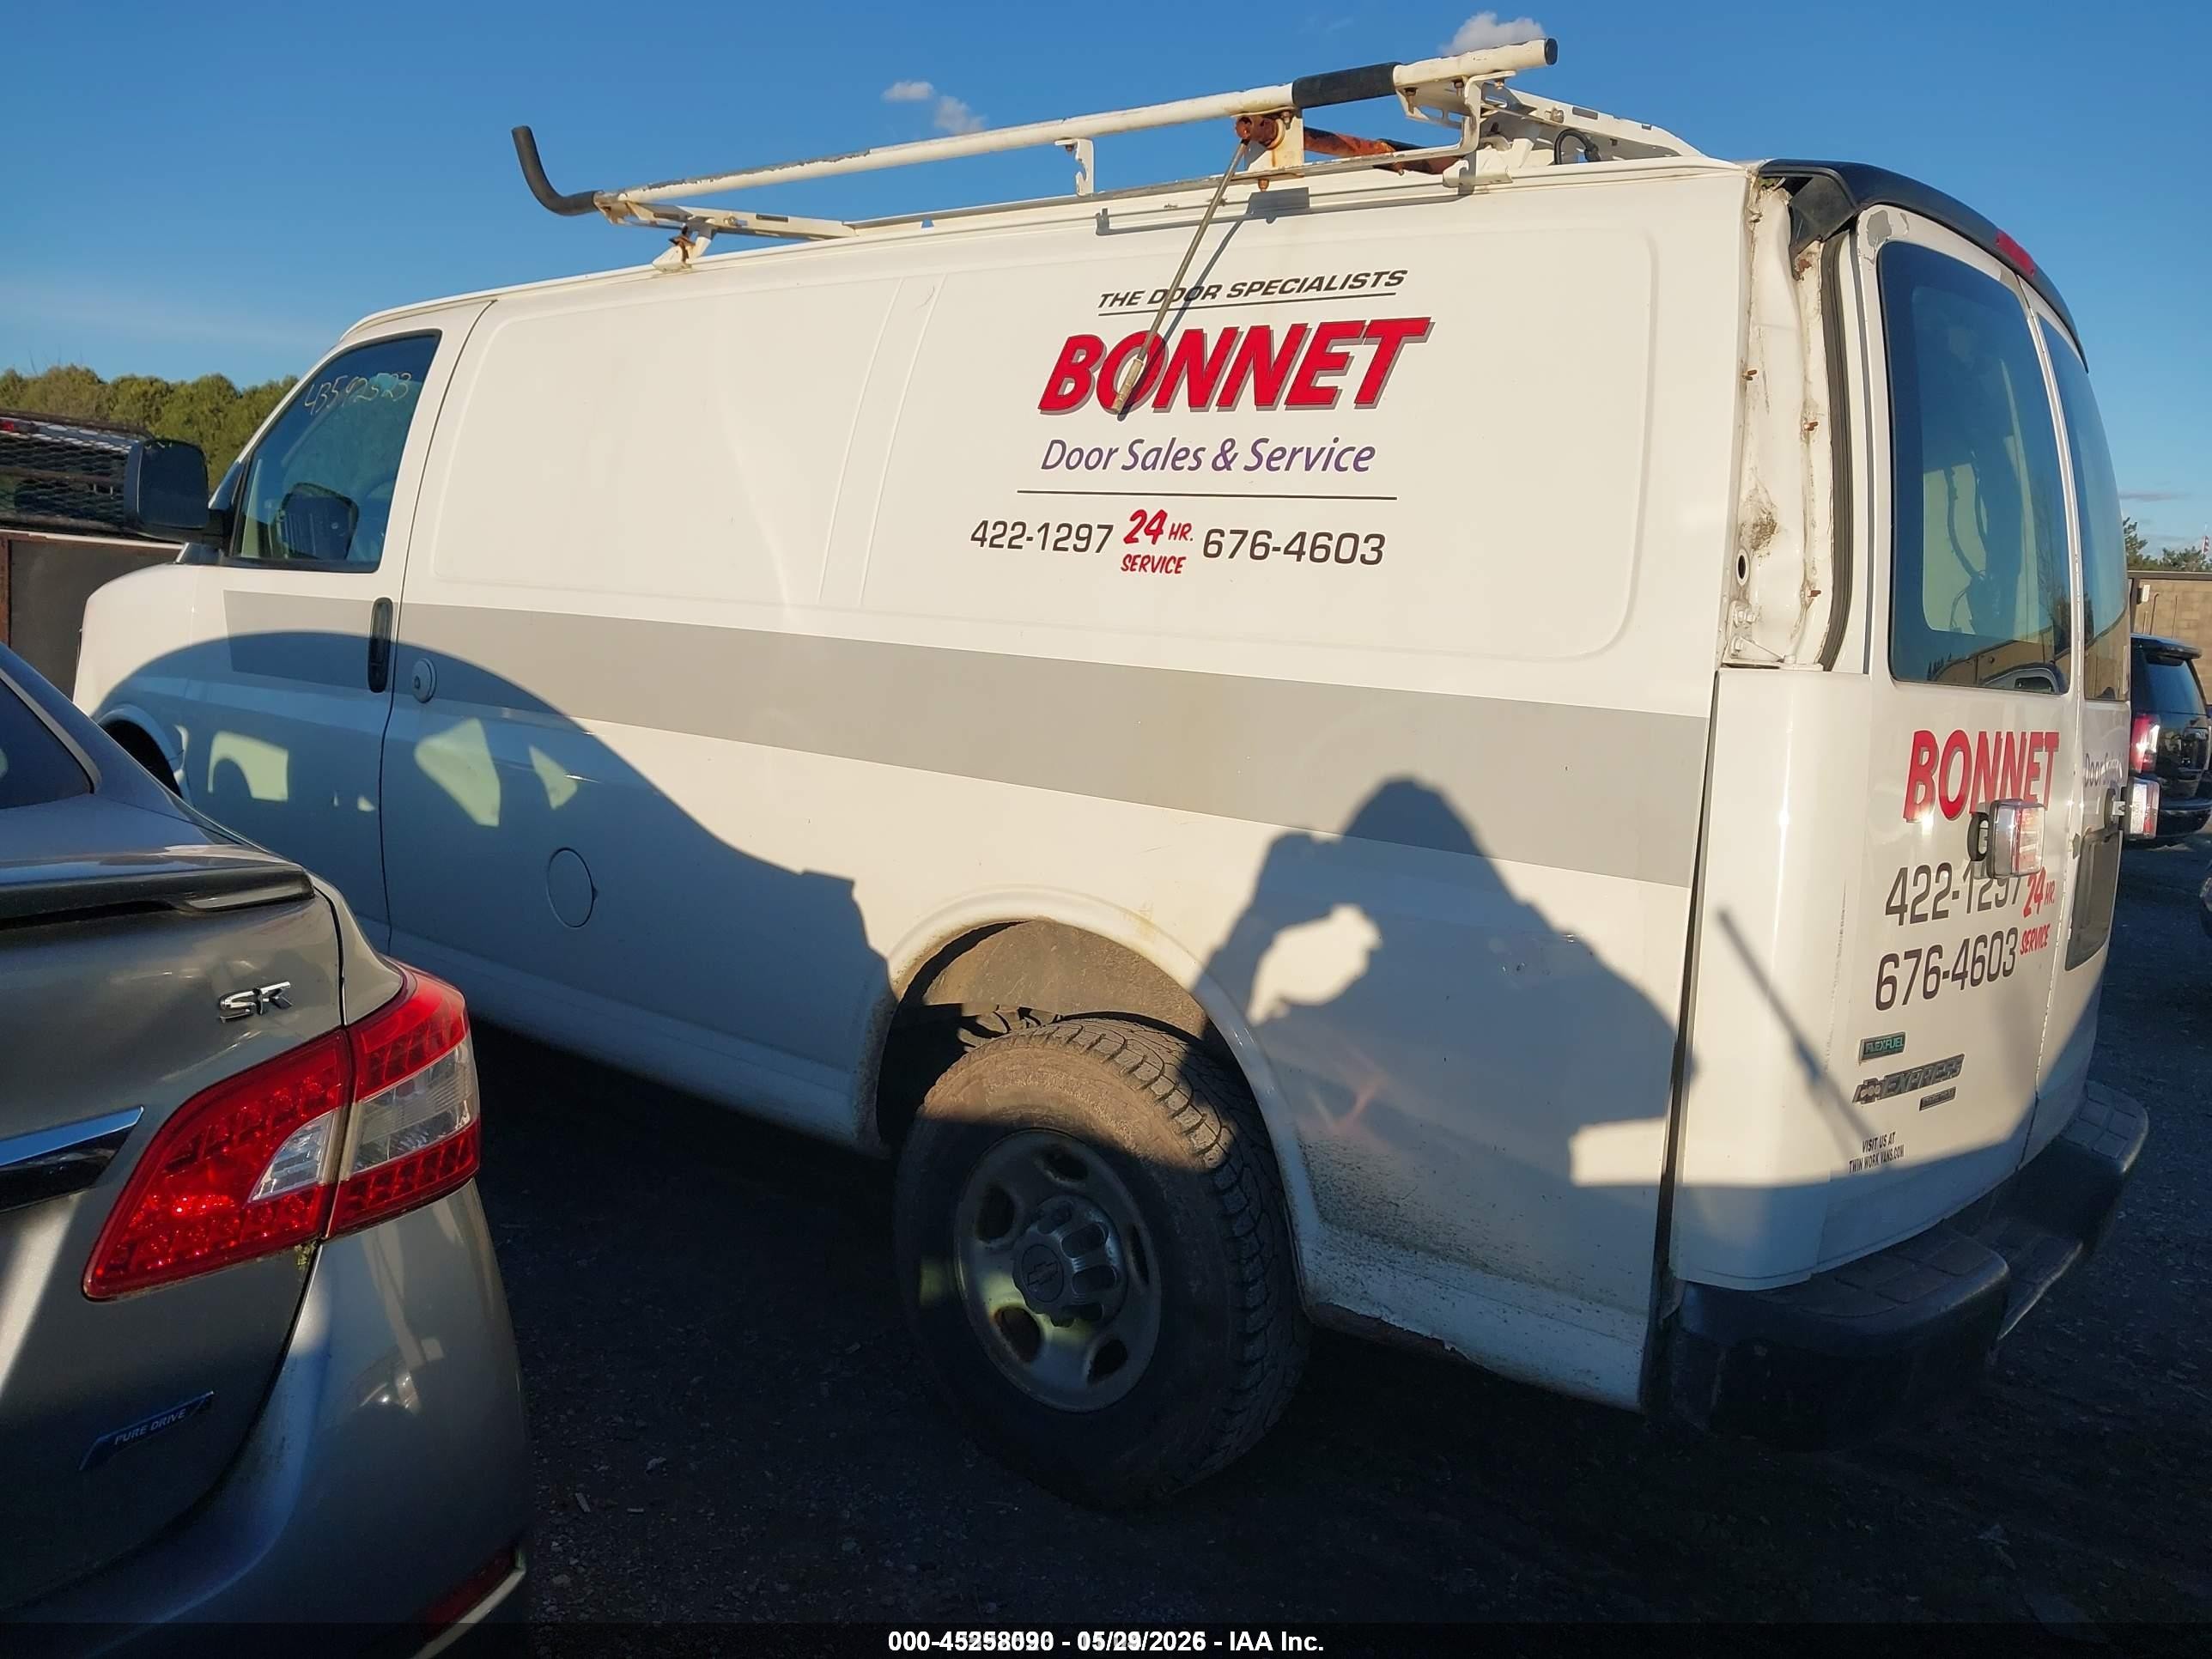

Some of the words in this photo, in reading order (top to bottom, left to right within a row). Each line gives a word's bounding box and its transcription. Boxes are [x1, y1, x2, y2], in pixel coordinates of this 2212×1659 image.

[1098, 289, 1146, 308] THE
[1147, 284, 1223, 305] DOOR
[1226, 270, 1408, 299] SPECIALISTS
[1037, 317, 1436, 415] BONNET
[1042, 440, 1119, 471] Door
[1121, 437, 1206, 471] Sales
[1212, 438, 1238, 471] &
[1244, 437, 1376, 472] Service
[970, 520, 1113, 554] 422-1297
[1123, 510, 1168, 544] 24
[1168, 523, 1194, 542] HR.
[1121, 554, 1186, 574] SERVICE
[1203, 529, 1386, 565] 676-4603
[1903, 729, 2059, 822] BONNET
[2023, 866, 2047, 918] 24
[2020, 923, 2051, 956] SERVICE
[1875, 927, 2018, 1012] 676-4603
[220, 981, 293, 1023] SR
[1865, 1036, 1904, 1054] FLEXFUEL
[1882, 1059, 1962, 1096] EXPRESS
[1849, 1158, 1863, 1174] TWIN
[1863, 1153, 1880, 1169] WORK
[1881, 1144, 1905, 1164] VANS.COM
[1862, 1136, 1878, 1153] VISIT
[1879, 1134, 1887, 1148] US
[1887, 1131, 1896, 1146] AT
[114, 1425, 148, 1445] PURE
[150, 1408, 186, 1431] DRIVE
